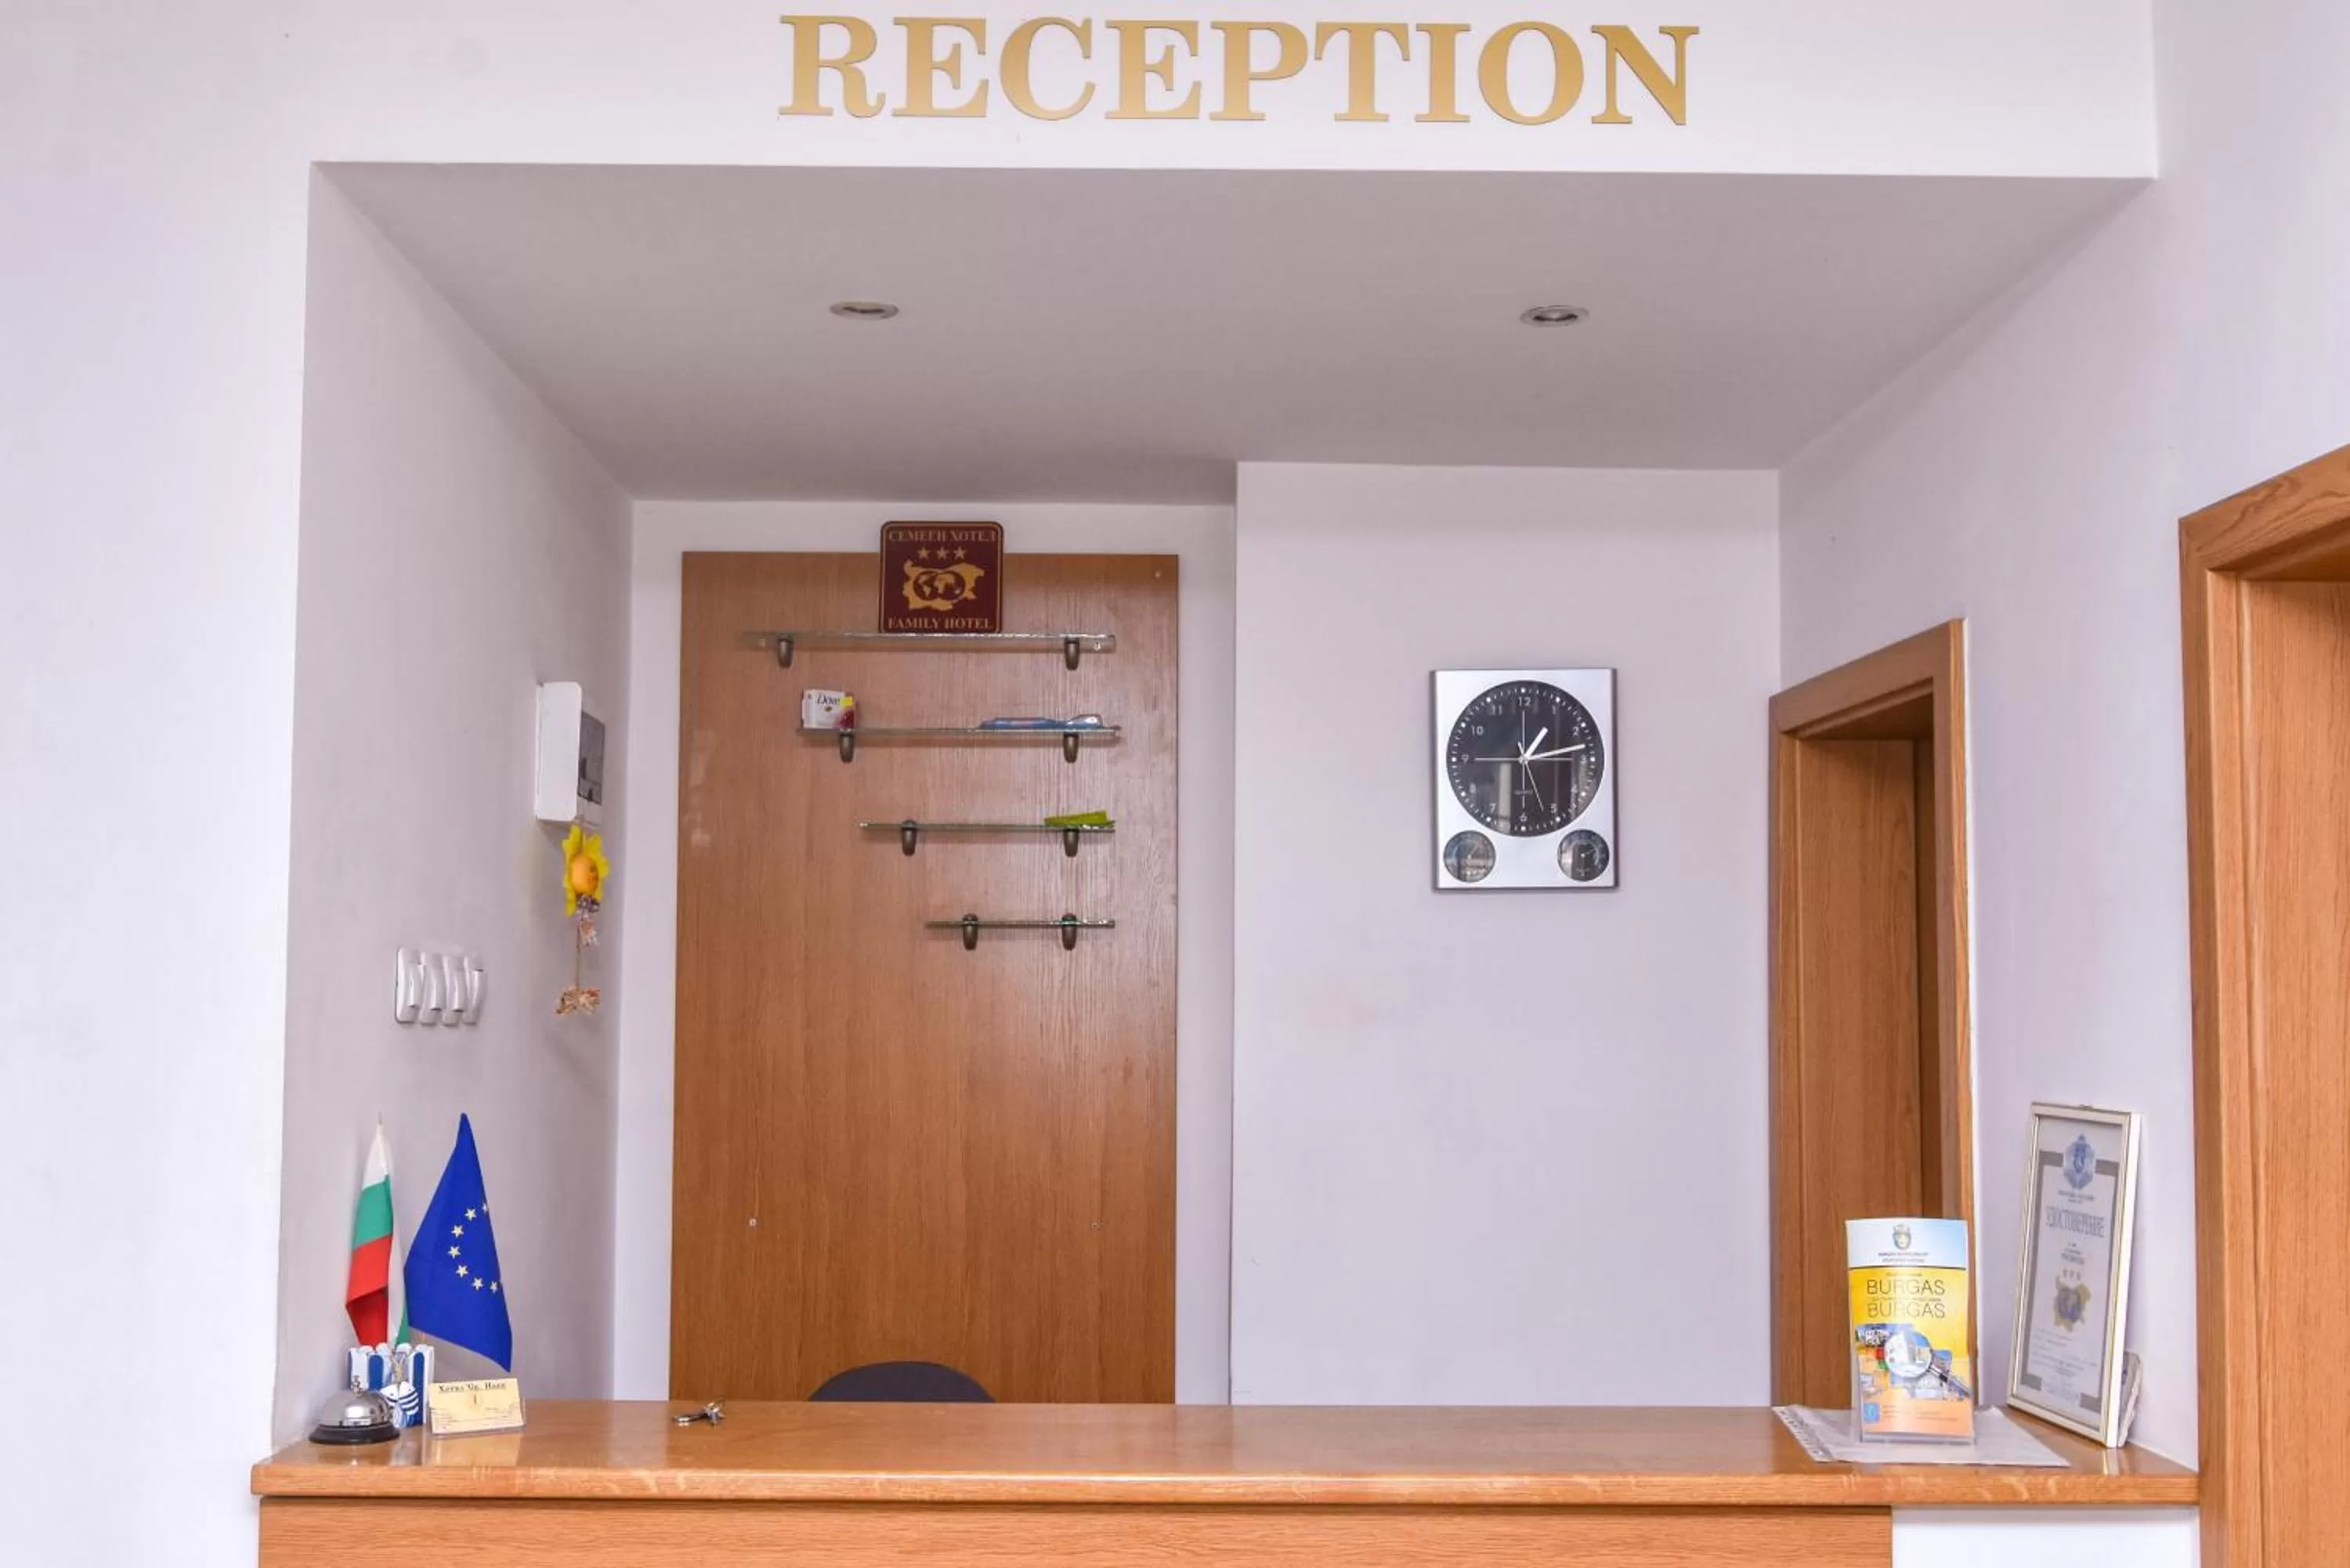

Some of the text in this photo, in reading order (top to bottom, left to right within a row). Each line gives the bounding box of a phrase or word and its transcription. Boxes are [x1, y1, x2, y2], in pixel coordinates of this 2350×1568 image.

[778, 15, 1699, 126] RECEPTION
[888, 617, 992, 630] FAMILY HOTEL
[1518, 697, 1531, 706] 12
[1471, 726, 1484, 735] 10
[1572, 726, 1580, 736] 2
[1867, 1278, 1946, 1296] BURGAS
[1867, 1301, 1946, 1319] BURGAS
